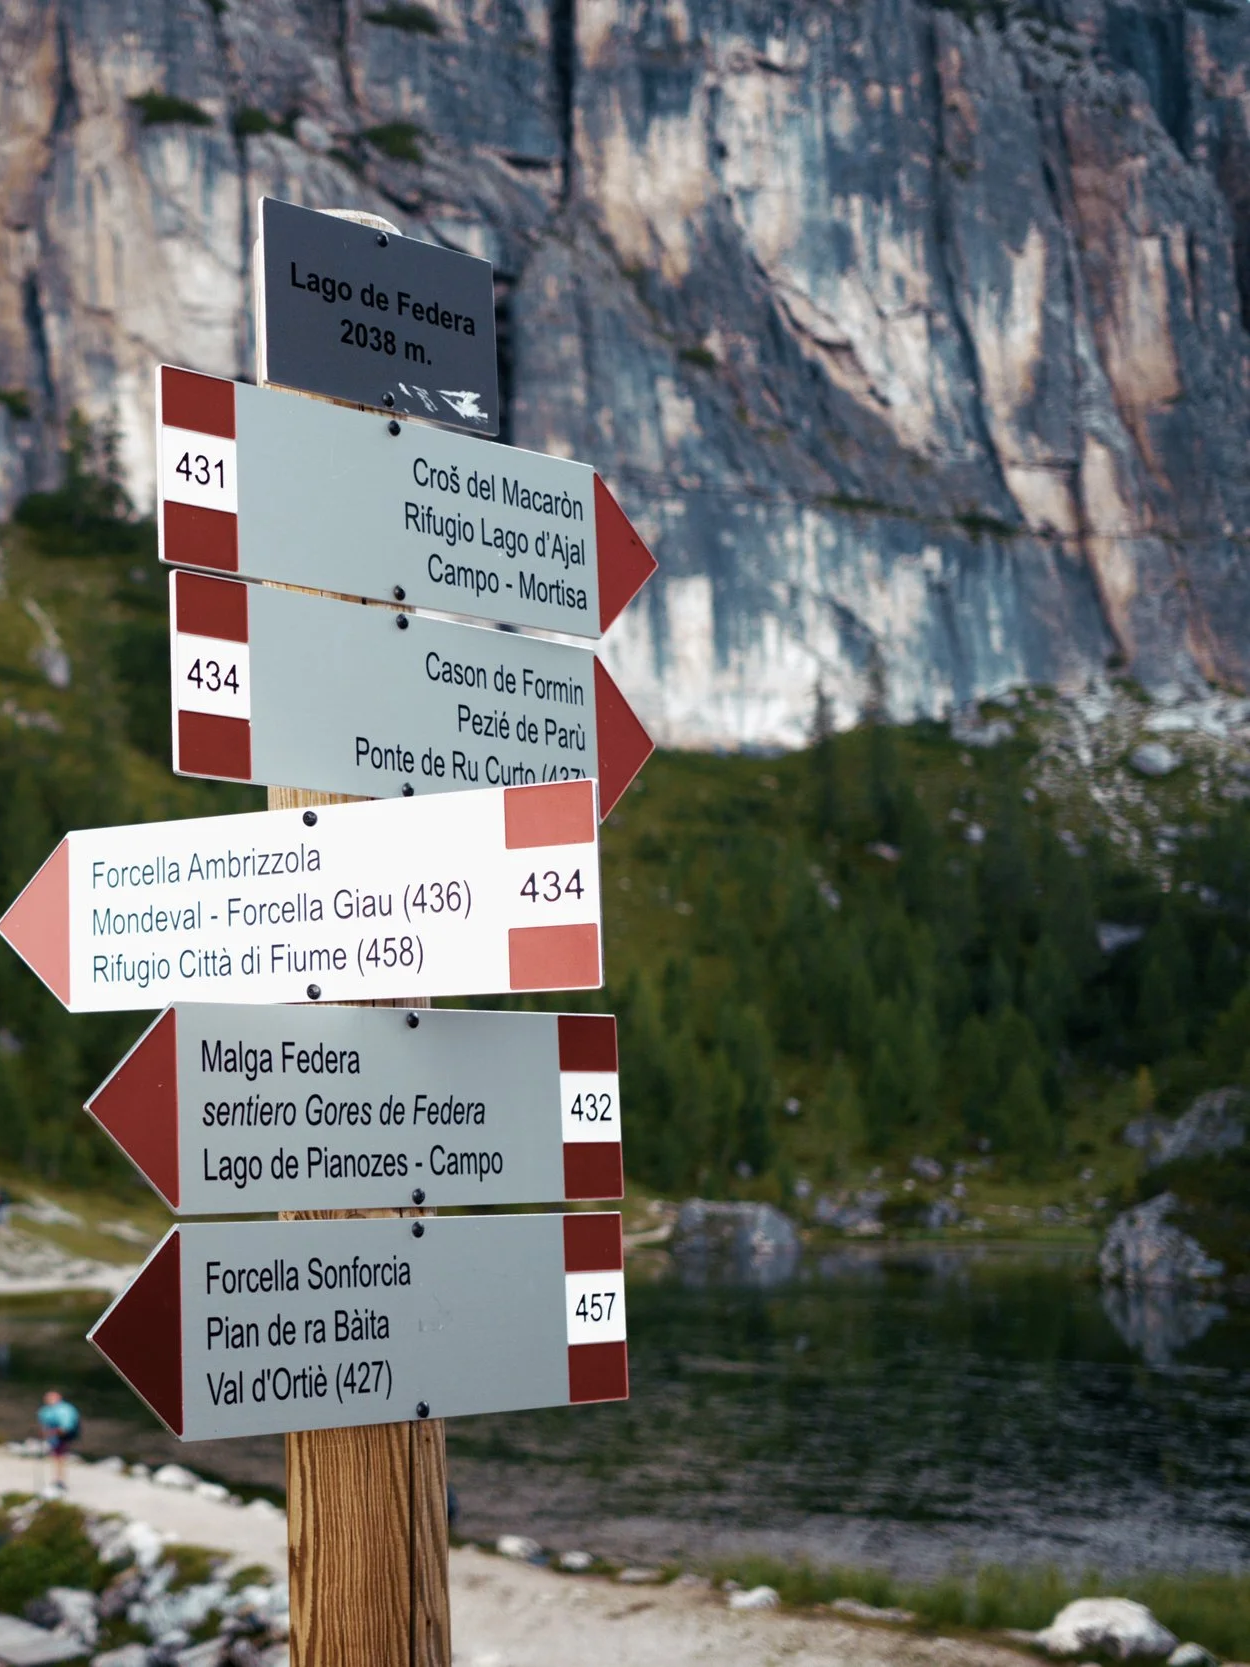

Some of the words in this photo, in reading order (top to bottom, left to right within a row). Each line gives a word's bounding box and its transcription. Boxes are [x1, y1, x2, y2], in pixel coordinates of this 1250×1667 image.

[290, 261, 353, 304] Lago
[360, 282, 389, 312] de
[397, 291, 476, 337] Federa
[340, 318, 397, 356] 2038
[404, 341, 432, 366] m.
[175, 451, 224, 489] 431
[413, 457, 461, 494] Croš
[466, 470, 496, 502] del
[502, 477, 584, 522] Macaròn
[404, 501, 475, 547] Rifugio
[480, 517, 529, 557] Lago
[427, 553, 500, 598] Campo
[519, 570, 588, 611] Mortisa
[187, 658, 240, 695] 434
[425, 651, 487, 690] Cason
[493, 664, 517, 695] de
[522, 668, 584, 706] Formin
[457, 703, 510, 740] Pezié
[516, 714, 539, 744] de
[544, 717, 586, 752] Parù
[355, 736, 415, 774] Ponte
[421, 747, 446, 778] de
[452, 750, 479, 782] Ru
[485, 755, 536, 786] Curto
[543, 764, 586, 782] (43
[92, 855, 181, 889] Forcella
[187, 842, 321, 882] Ambrizzola
[519, 868, 585, 903] 434
[92, 900, 201, 936] Mondeval
[227, 892, 324, 927] Forcella
[333, 888, 392, 920] Giau
[403, 879, 472, 923] (436)
[93, 953, 171, 989] Rifugio
[179, 947, 232, 979] Città
[241, 945, 261, 976] di
[271, 943, 347, 974] Fiume
[357, 935, 424, 977] (458)
[201, 1039, 273, 1082] Malga
[281, 1041, 361, 1075] Federa
[202, 1093, 297, 1127] sentiero
[305, 1093, 373, 1127] Gores
[379, 1094, 406, 1126] de
[413, 1094, 486, 1126] Federa
[570, 1093, 612, 1122] 432
[203, 1148, 263, 1190] Lago
[270, 1147, 299, 1180] de
[307, 1146, 408, 1179] Pianozes
[429, 1144, 503, 1183] Campo
[206, 1258, 300, 1295] Forcella
[307, 1254, 411, 1291] Sonforcia
[207, 1316, 260, 1351] Pian
[267, 1313, 297, 1347] de
[304, 1318, 326, 1344] ra
[334, 1308, 390, 1342] Bàita
[575, 1292, 616, 1322] 457
[206, 1370, 244, 1406] Val
[251, 1368, 328, 1403] d'Ortiè
[335, 1359, 393, 1405] (427)
